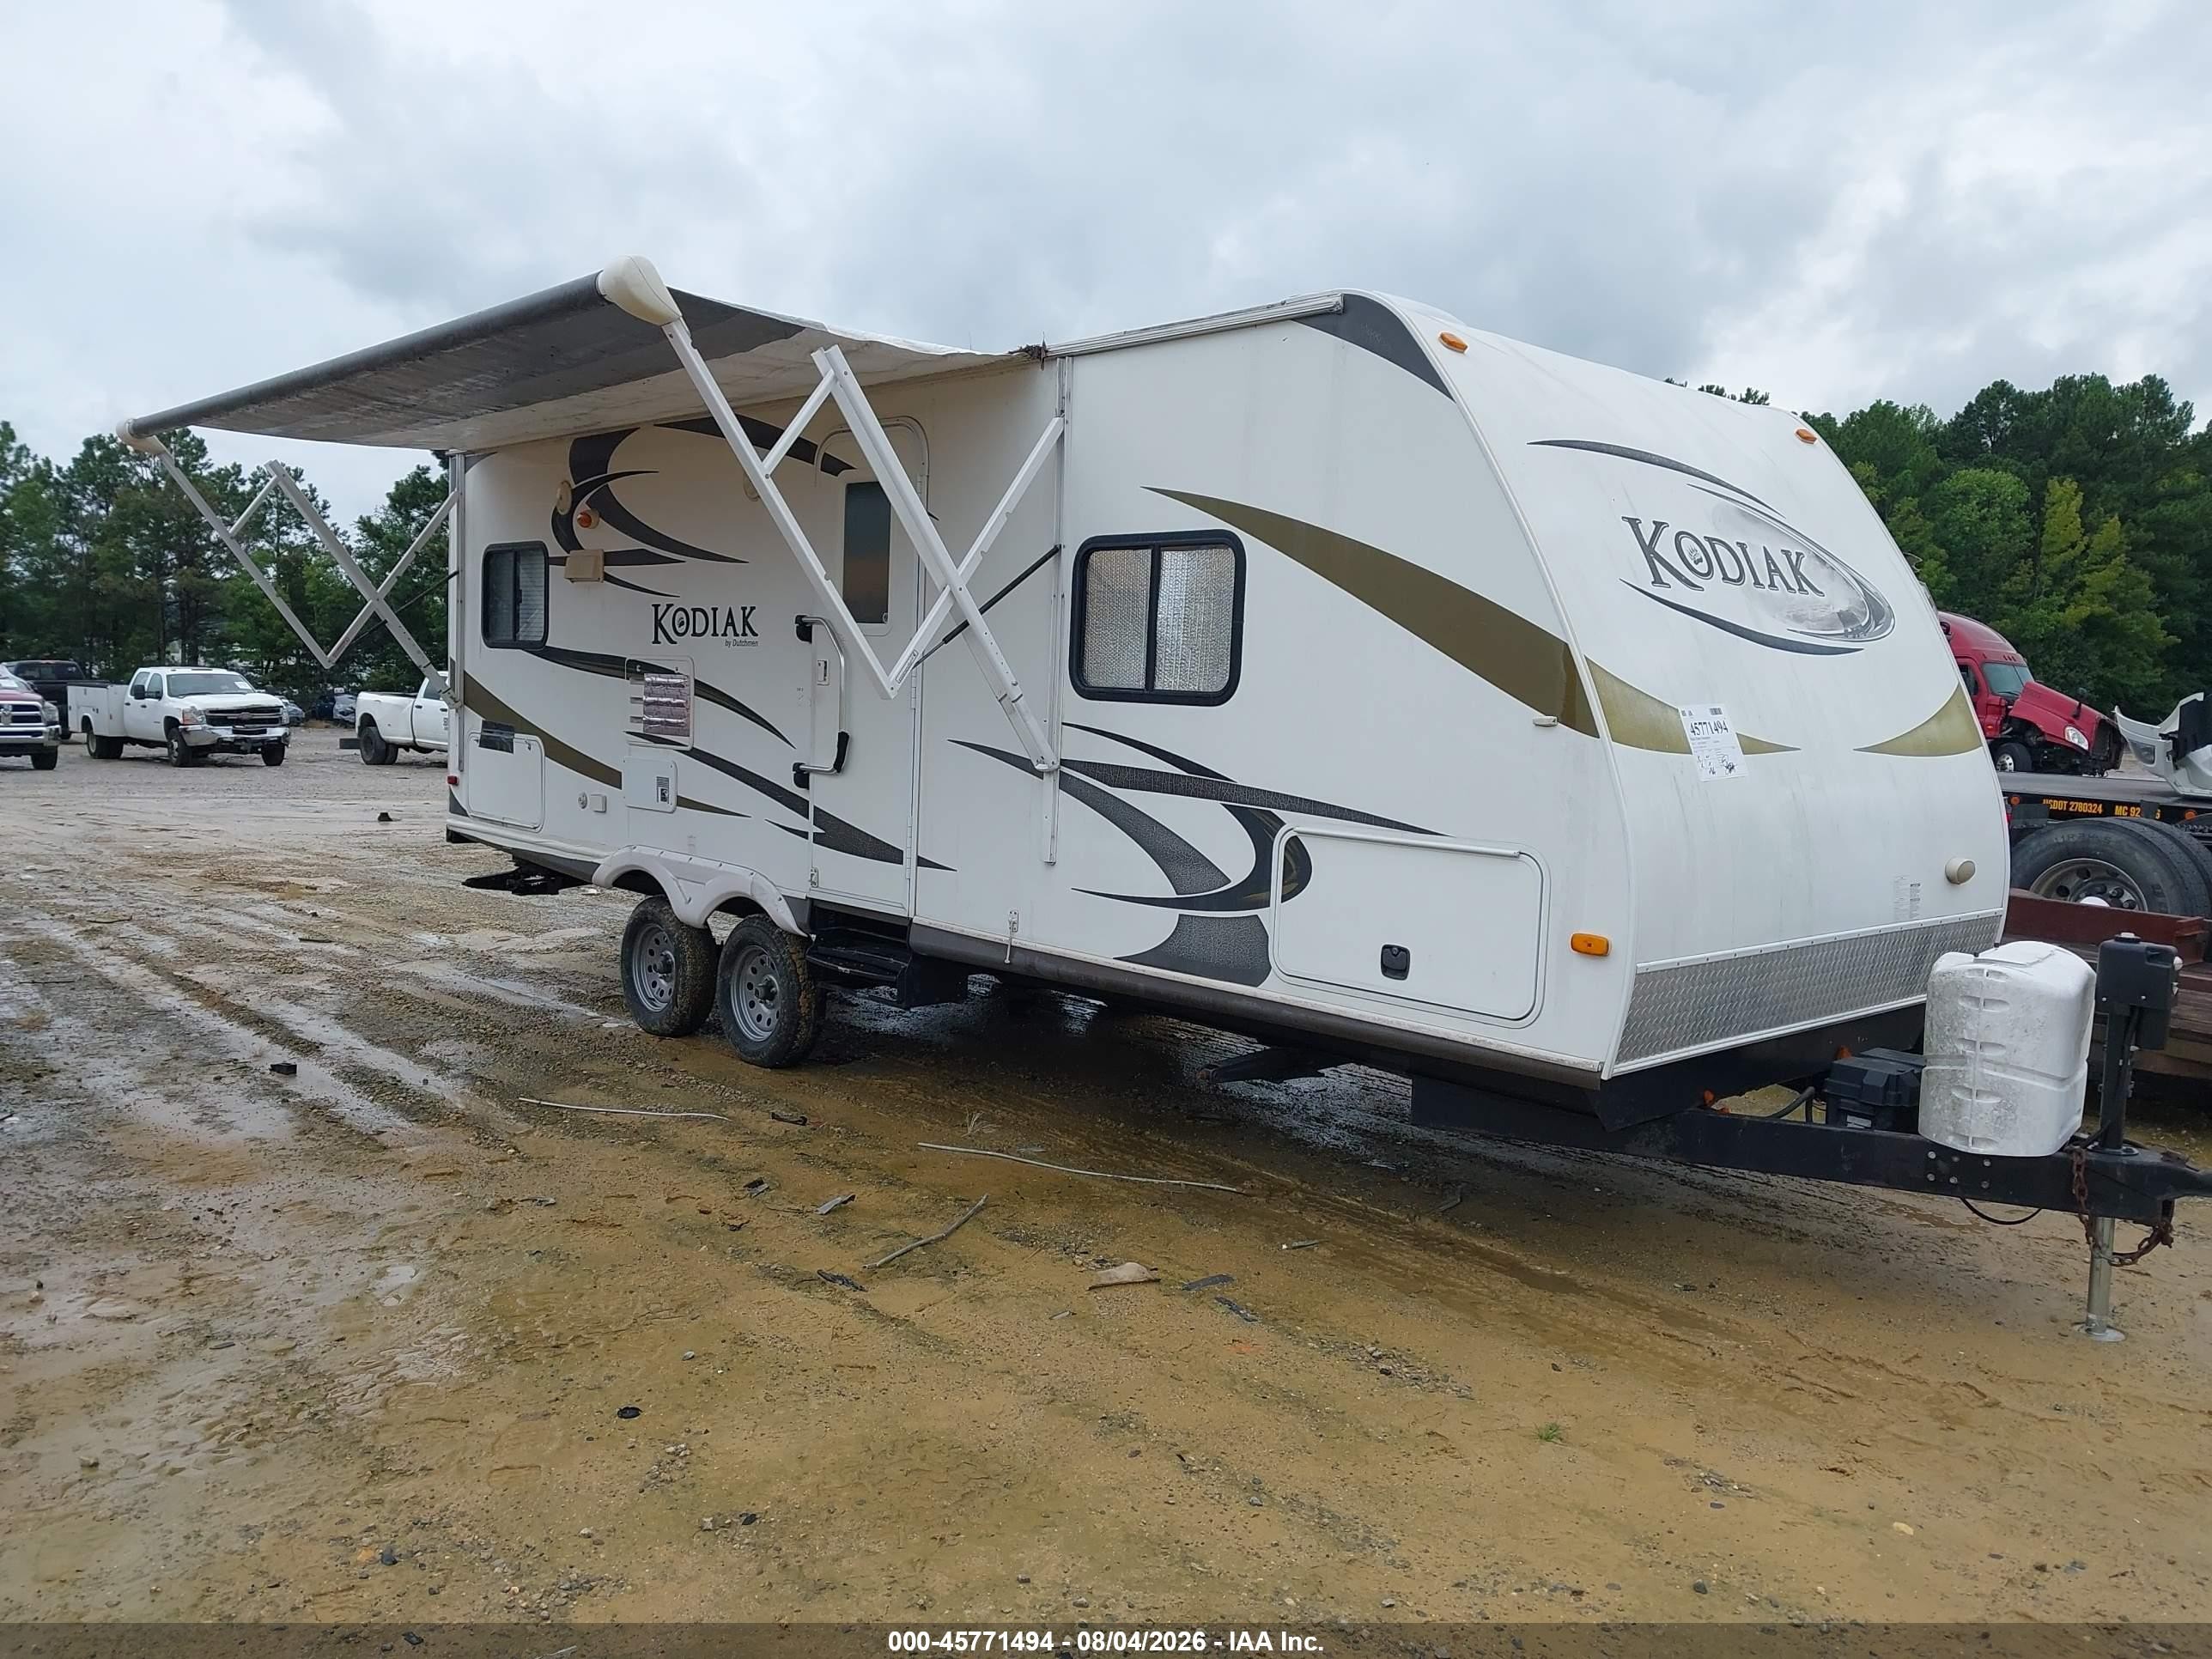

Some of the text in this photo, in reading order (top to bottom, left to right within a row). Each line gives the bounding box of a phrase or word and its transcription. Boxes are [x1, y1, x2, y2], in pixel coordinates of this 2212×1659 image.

[1621, 515, 1825, 598] KODIAK
[651, 603, 759, 645] KODIAK
[1689, 720, 1729, 736] 45771494
[2069, 800, 2103, 814] 2780324
[2114, 805, 2129, 817] MC
